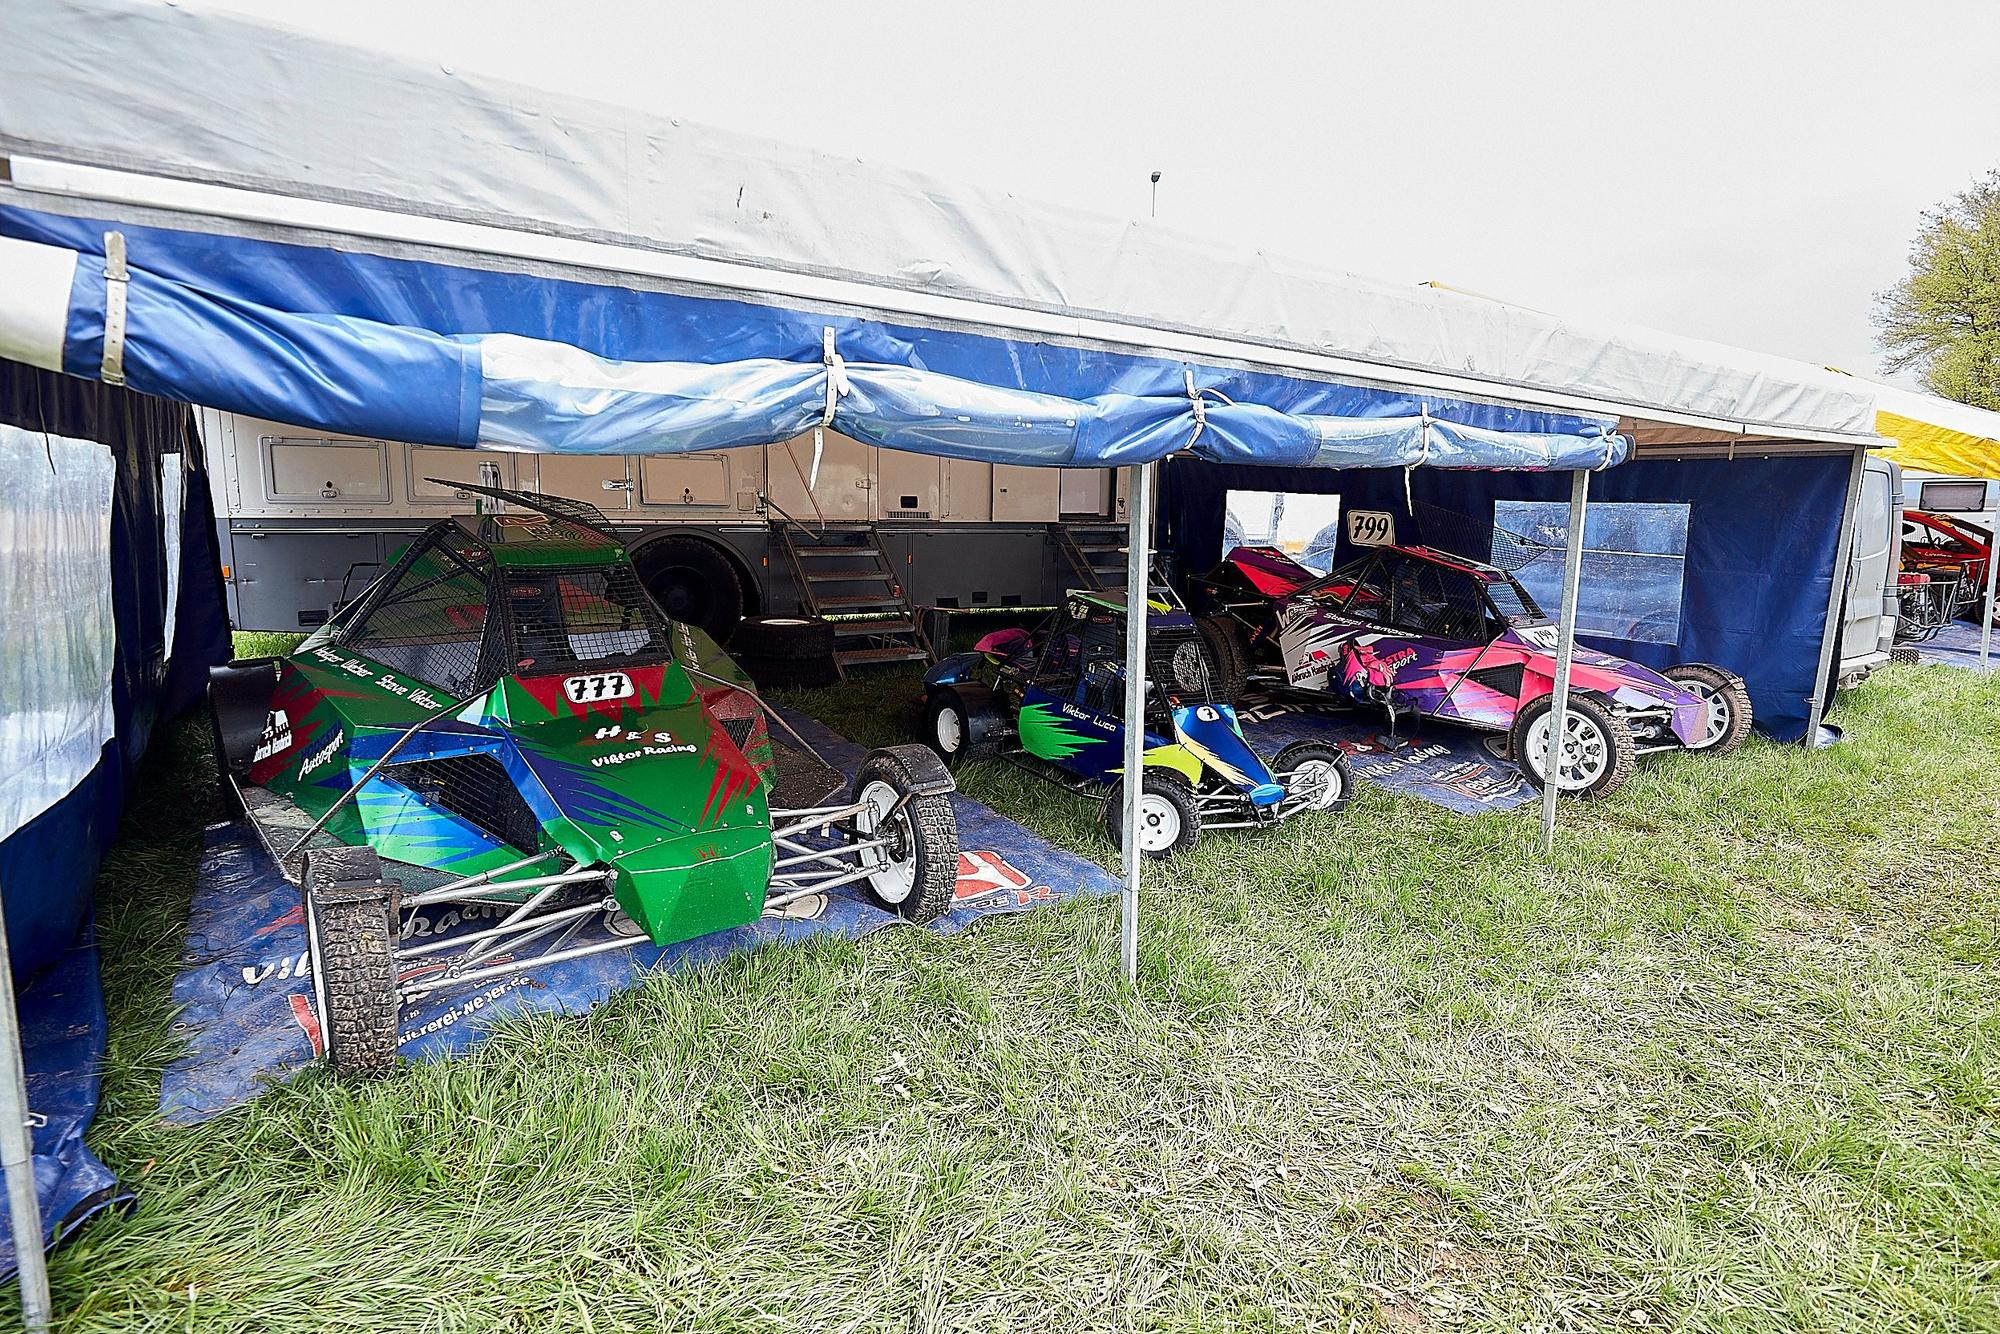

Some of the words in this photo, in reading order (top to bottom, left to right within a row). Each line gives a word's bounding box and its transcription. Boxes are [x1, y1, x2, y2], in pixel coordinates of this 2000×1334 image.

[1353, 515, 1389, 541] 799
[1535, 629, 1555, 642] 799
[375, 674, 408, 695] Steve
[406, 688, 443, 710] Viktor
[570, 675, 624, 700] 777
[1062, 702, 1091, 721] Viktor
[1093, 716, 1117, 732] Luca
[1203, 708, 1214, 719] 7
[595, 725, 622, 739] H
[626, 731, 642, 740] &
[654, 732, 672, 743] S
[297, 729, 344, 782] Autosport
[591, 750, 642, 767] Viktor
[642, 744, 697, 755] Racing
